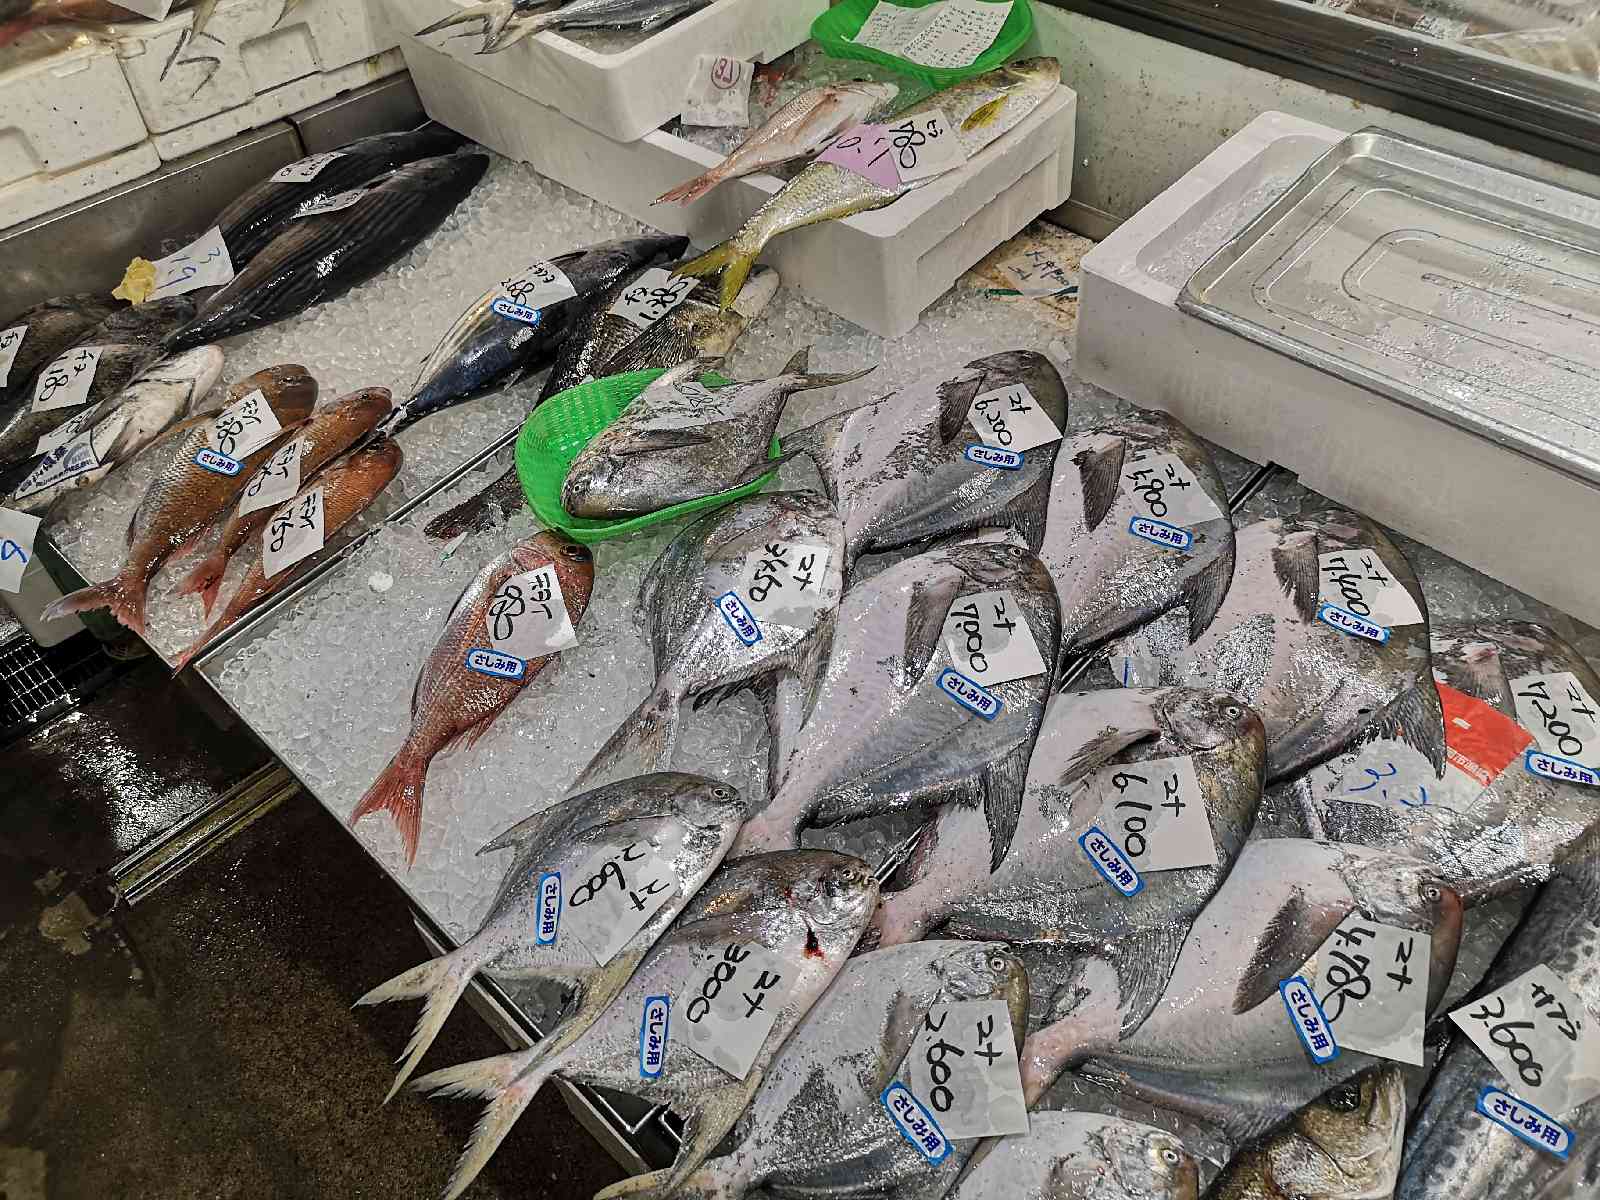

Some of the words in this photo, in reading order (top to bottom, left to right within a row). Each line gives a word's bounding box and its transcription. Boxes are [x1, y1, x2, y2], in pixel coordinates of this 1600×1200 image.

[201, 452, 236, 472] さしみ用
[972, 448, 1016, 466] さしみ用
[1137, 522, 1183, 546] さしみ用
[723, 598, 758, 639] さしみ用
[1328, 610, 1380, 639] さしみ用
[474, 652, 518, 674] さしみ用
[946, 675, 994, 714] さしみ用
[1535, 757, 1595, 784] さしみ用
[1089, 836, 1135, 888] さしみ用
[541, 881, 558, 935] さしみ用
[646, 1006, 665, 1066] さしみ用
[1290, 988, 1331, 1051] さしみ用
[892, 1093, 943, 1155] さしみ用
[1492, 1098, 1562, 1148] さしみ用
